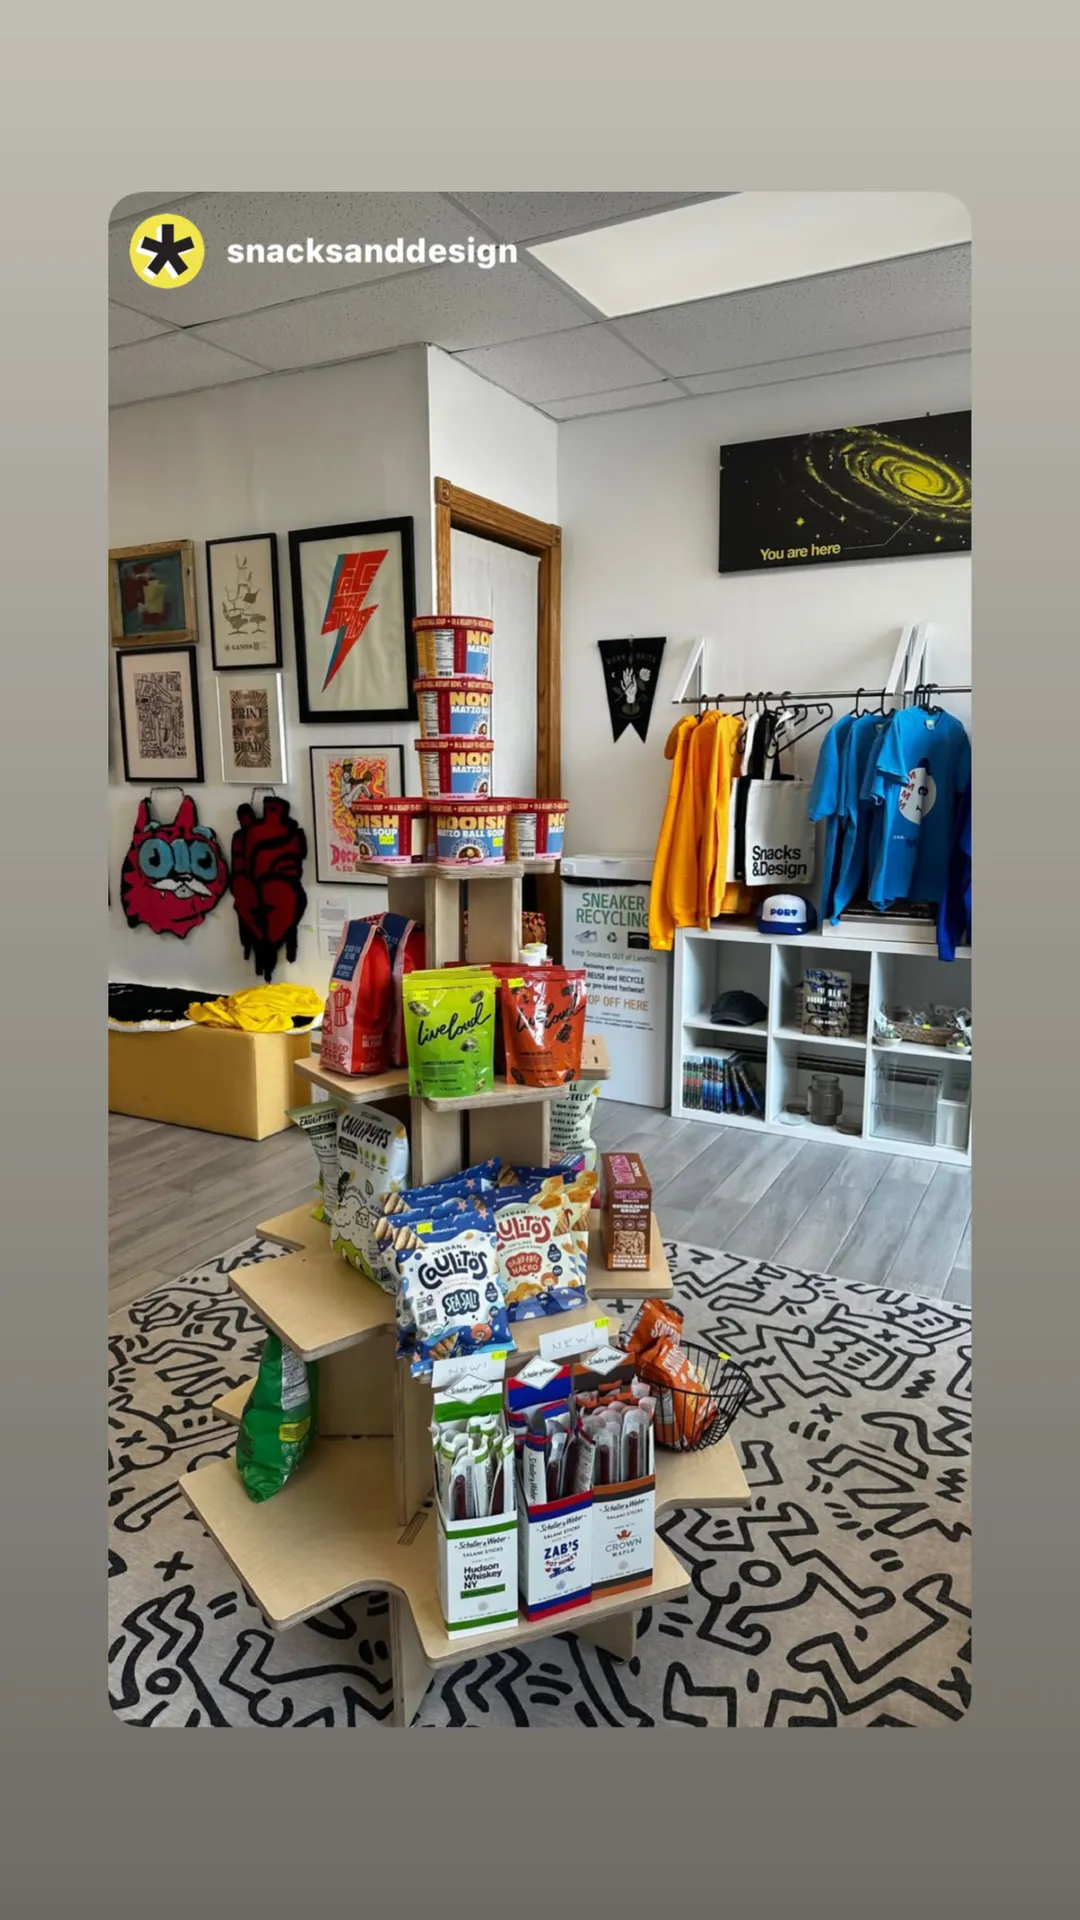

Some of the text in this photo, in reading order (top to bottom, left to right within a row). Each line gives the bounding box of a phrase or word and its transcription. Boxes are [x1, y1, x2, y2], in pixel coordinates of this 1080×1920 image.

[760, 543, 841, 561] You are here
[232, 707, 263, 719] PRINT
[233, 741, 263, 753] DEAD
[436, 815, 506, 830] NOOISH
[372, 828, 398, 837] SOUP
[462, 829, 485, 838] BALL
[752, 845, 801, 861] Snacks
[752, 861, 807, 879] &Design
[582, 892, 645, 911] SNEAKER
[612, 952, 624, 960] OUT
[587, 971, 645, 985] REUSE and RECYCLE
[603, 995, 620, 1008] OFF
[623, 999, 649, 1012] HERE
[501, 1210, 527, 1218] VEGAN
[435, 1244, 462, 1255] VEGAN
[445, 1293, 461, 1313] SEA
[603, 1503, 625, 1513] Schaller
[628, 1498, 646, 1508] Weber
[540, 1521, 562, 1532] Schaller
[566, 1514, 584, 1525] Weber
[458, 1541, 483, 1550] Schaller
[486, 1536, 507, 1546] Weber
[484, 1546, 504, 1554] STICKS
[544, 1539, 579, 1560] ZAB'S
[605, 1537, 642, 1553] CROWN
[612, 1547, 636, 1558] MAPLE
[464, 1562, 499, 1574] Hudson
[464, 1570, 502, 1581] Whiskey
[464, 1581, 478, 1589] NY
